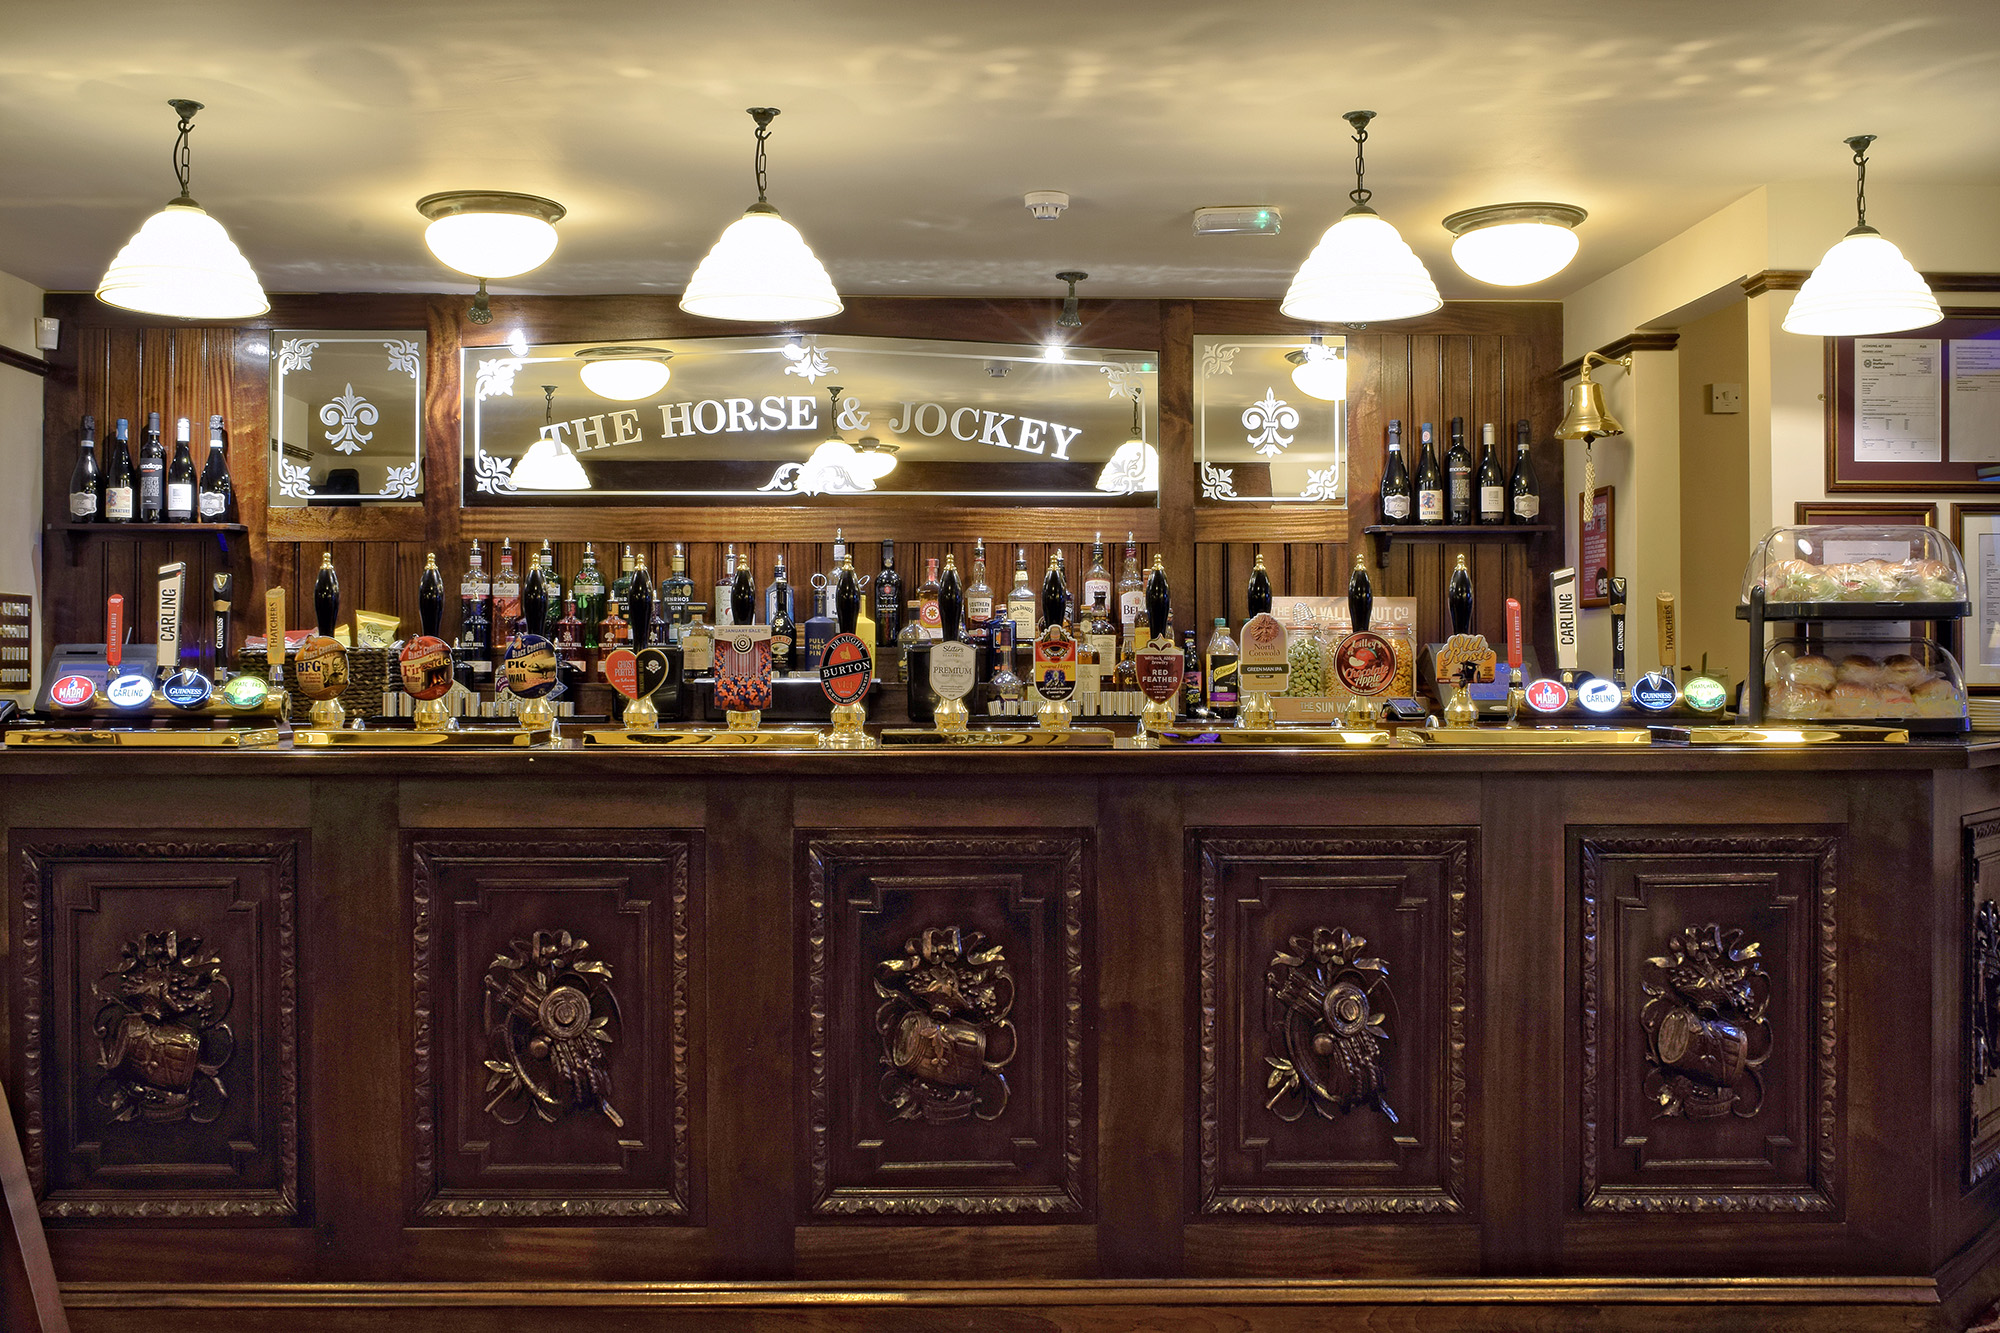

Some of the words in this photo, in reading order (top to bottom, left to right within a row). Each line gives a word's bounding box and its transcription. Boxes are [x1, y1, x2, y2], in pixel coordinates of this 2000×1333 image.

[540, 409, 642, 457] THE
[658, 396, 818, 438] HORSE
[836, 397, 871, 431] &
[888, 401, 1082, 461] JOCKEY
[160, 588, 176, 642] CARLING
[1559, 593, 1574, 645] CARLING
[512, 649, 526, 658] BLACK
[527, 642, 547, 653] COUNTRY
[830, 636, 865, 650] DRAUGHT
[1352, 639, 1382, 649] Lilley's
[1448, 636, 1483, 652] Old
[408, 651, 422, 660] BLACK
[1441, 647, 1492, 666] Rosie
[298, 661, 321, 672] BFG
[403, 655, 451, 676] Fireside
[823, 661, 870, 678] BURTON
[1345, 664, 1389, 678] Chocolate
[509, 674, 526, 683] WALL
[1354, 673, 1381, 687] Apple
[114, 689, 144, 697] CARLING
[1586, 694, 1615, 703] CARLING
[1316, 702, 1334, 713] SUN
